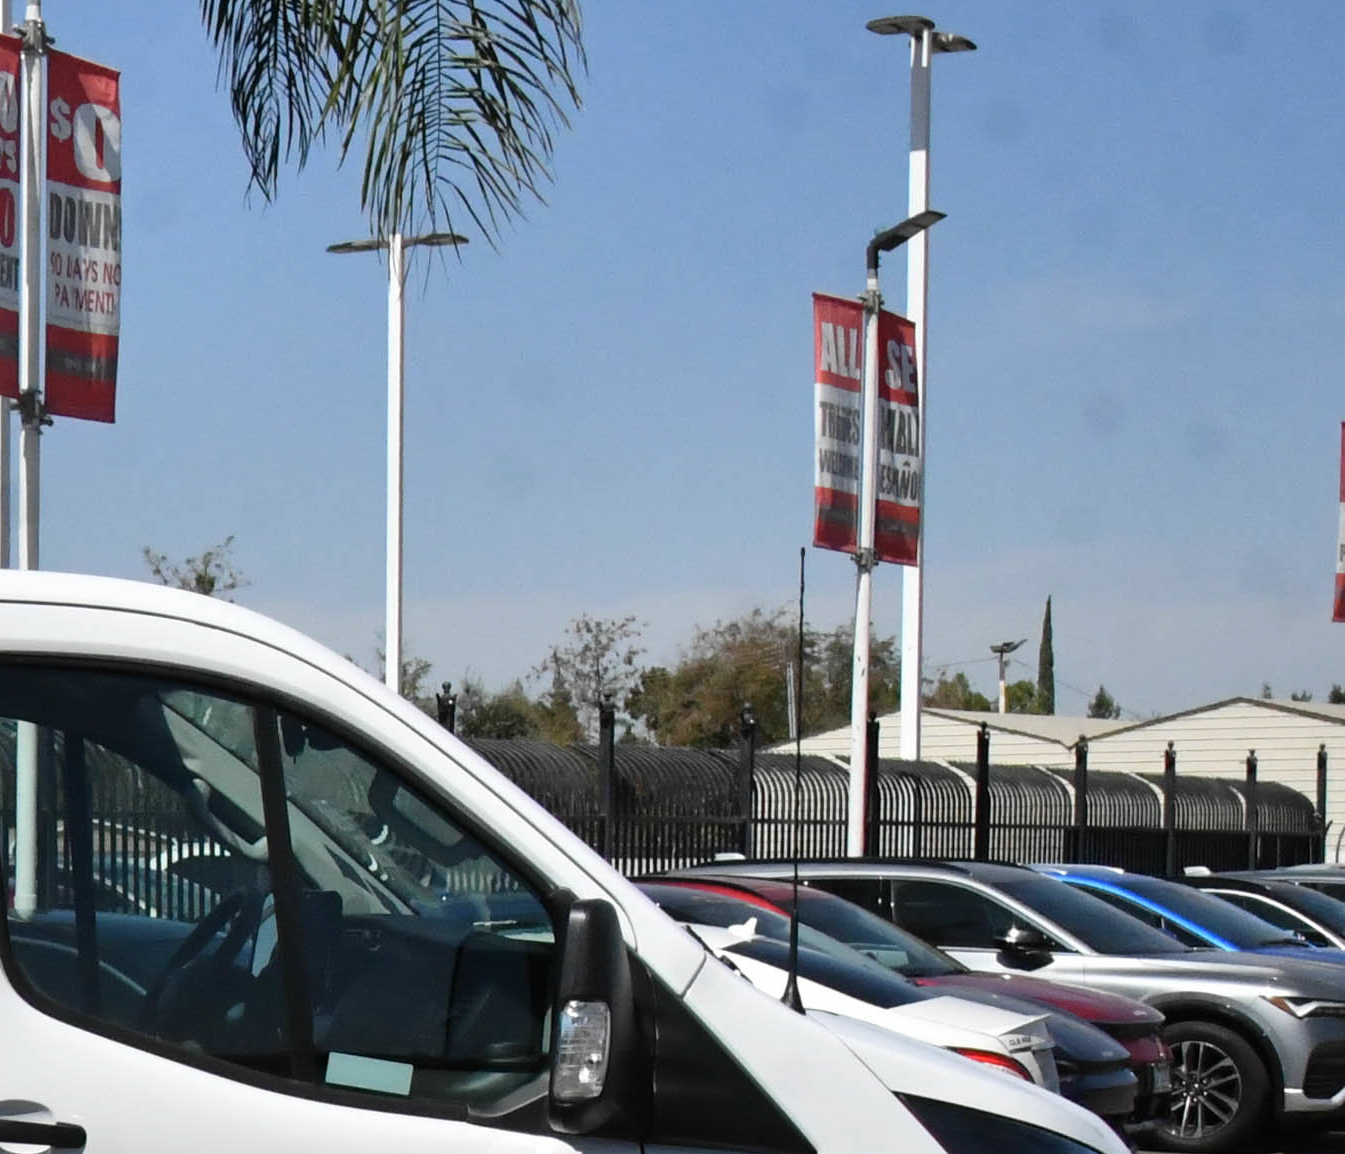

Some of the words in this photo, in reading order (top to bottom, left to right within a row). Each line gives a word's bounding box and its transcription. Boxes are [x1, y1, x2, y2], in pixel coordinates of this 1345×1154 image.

[49, 191, 121, 252] DOWN
[55, 282, 115, 317] PAMENT!
[820, 321, 861, 381] ALL
[885, 339, 916, 395] SE
